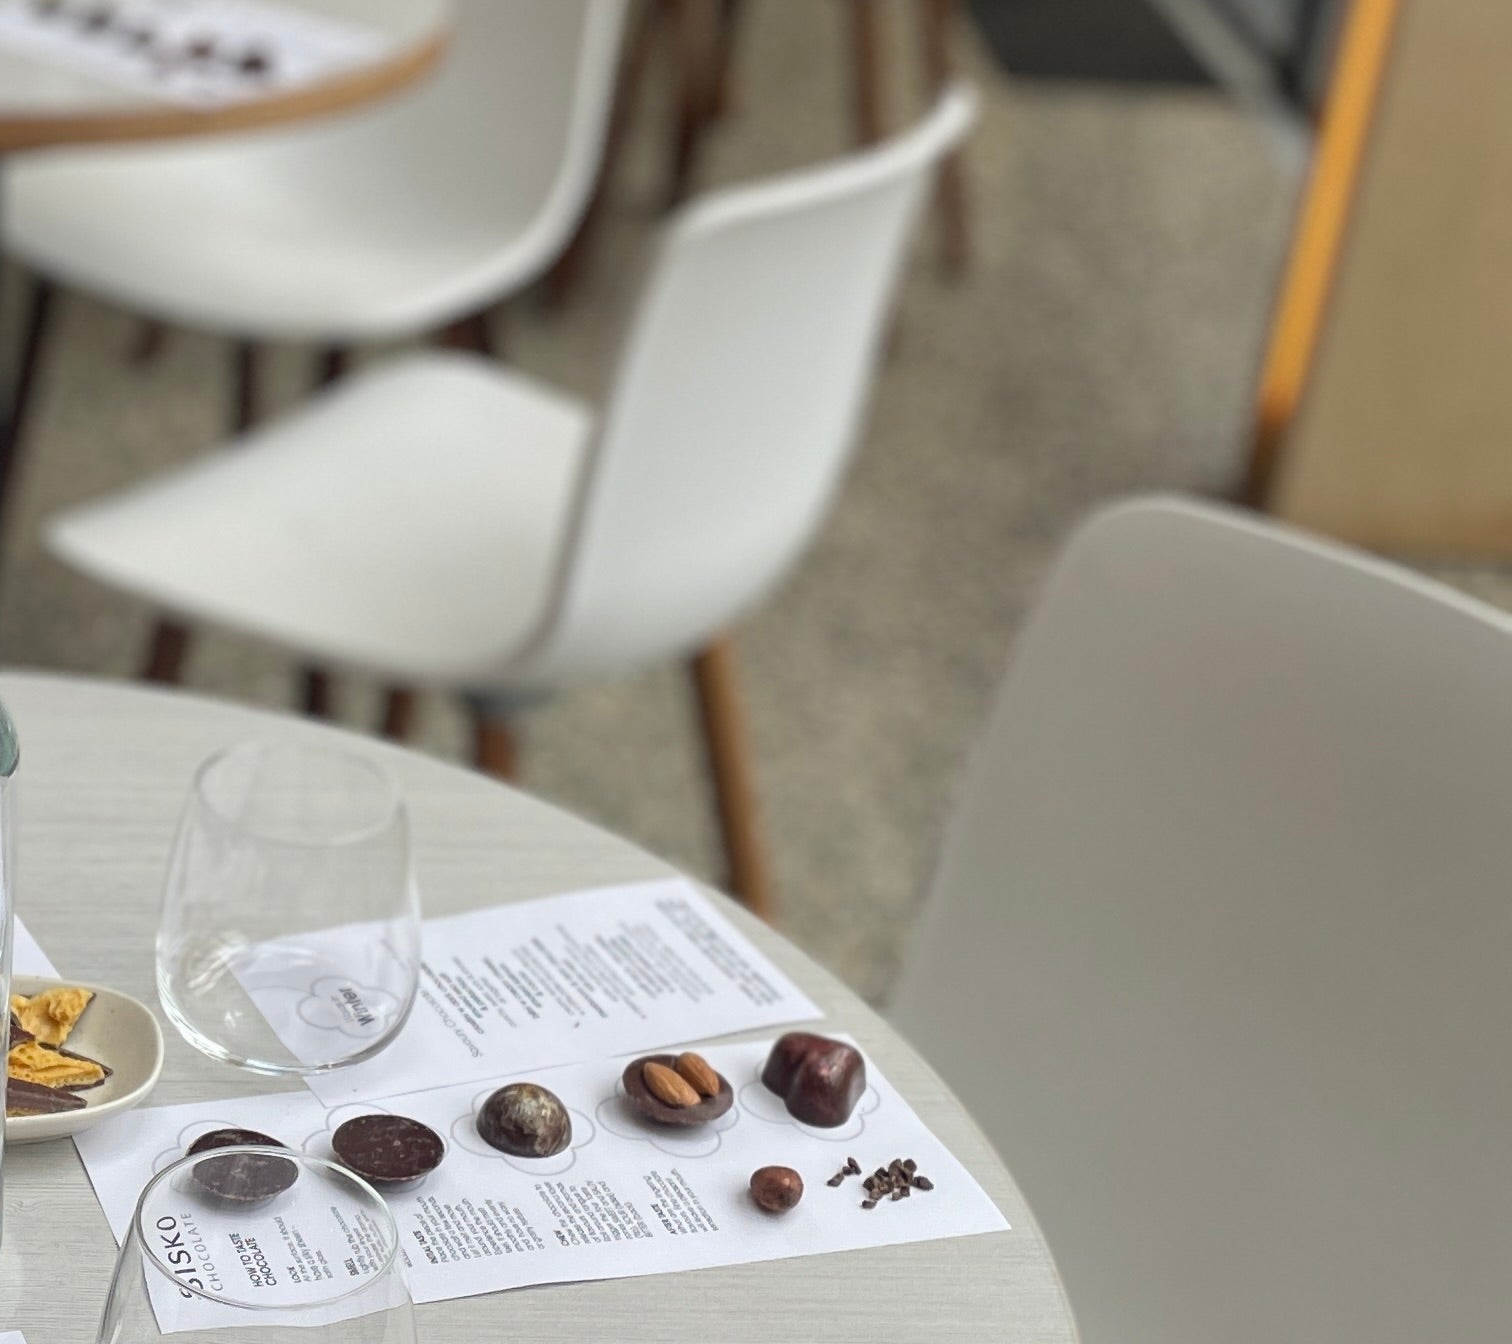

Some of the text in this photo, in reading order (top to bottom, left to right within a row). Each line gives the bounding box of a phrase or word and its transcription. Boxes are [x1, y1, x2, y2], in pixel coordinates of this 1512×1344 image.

[338, 987, 376, 1027] Winter
[180, 1212, 224, 1292] CHOCOLATE
[228, 1232, 248, 1254] TASTE
[244, 1236, 278, 1287] CHOCOLATE
[246, 1267, 265, 1288] HOW
